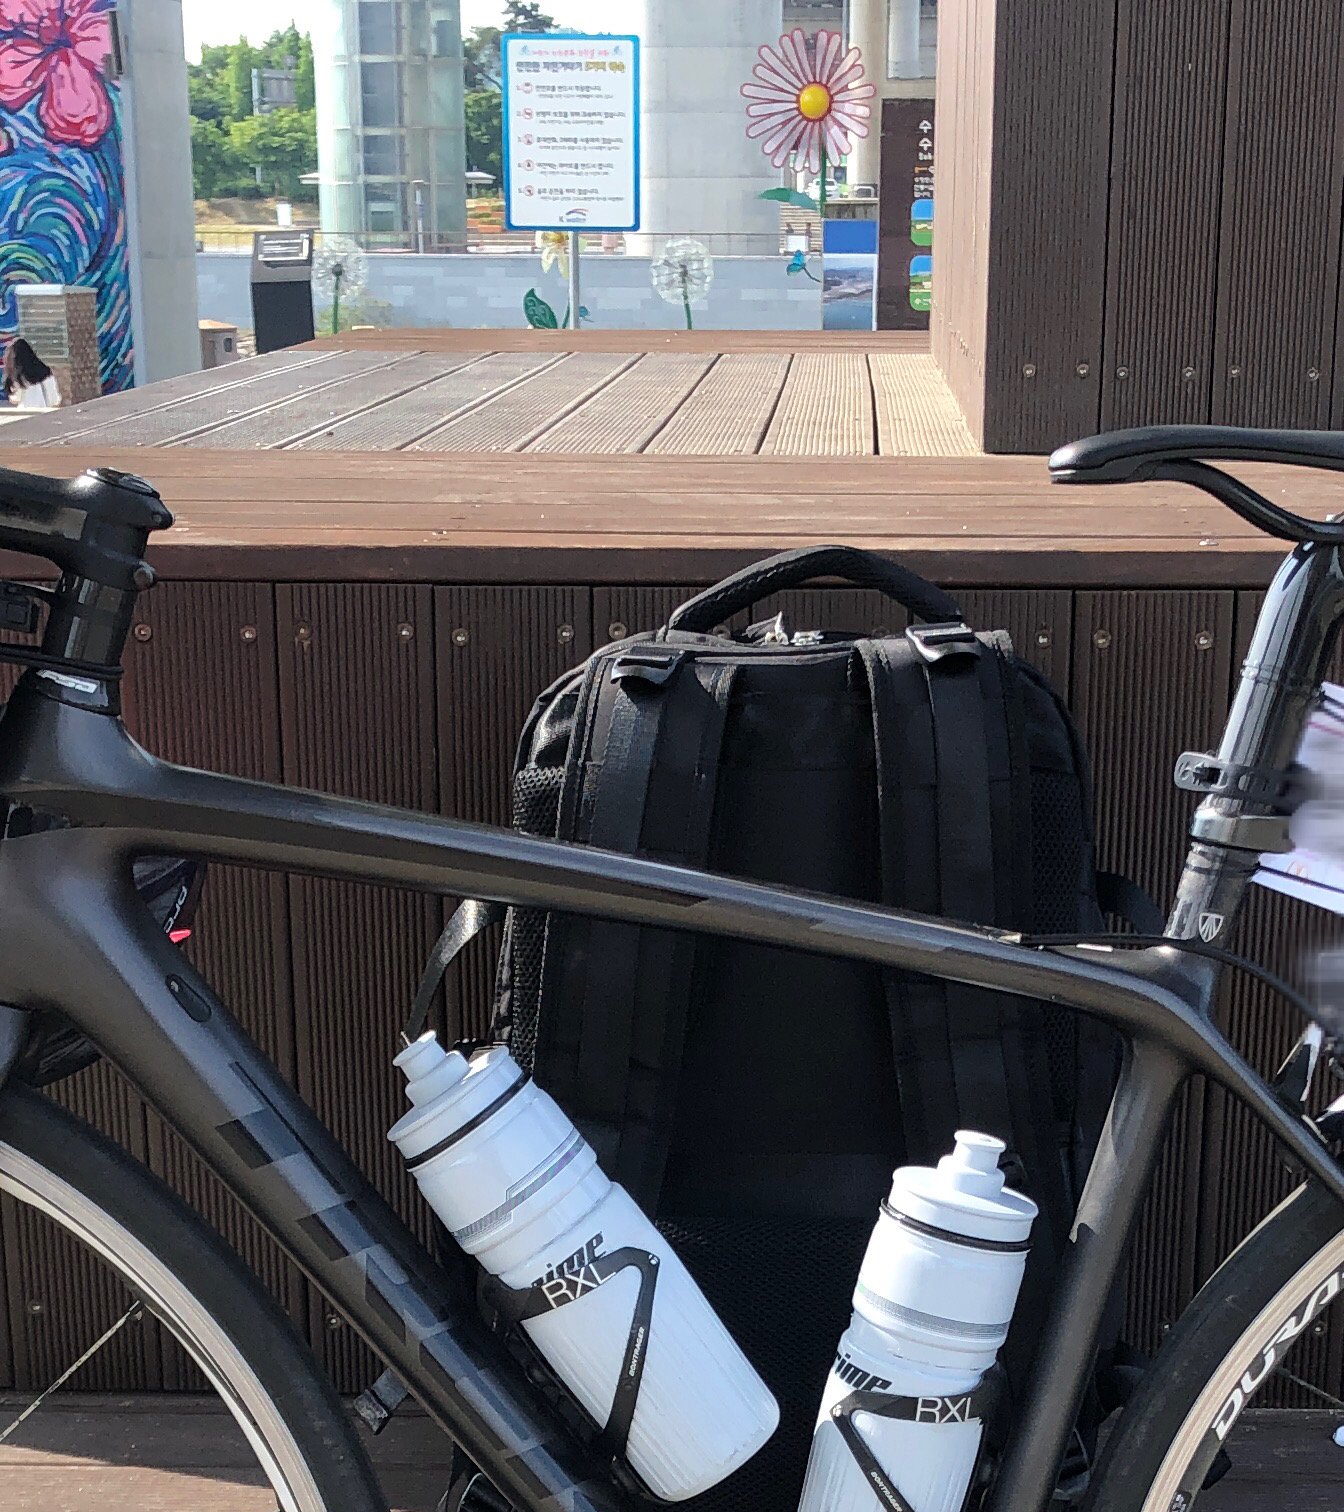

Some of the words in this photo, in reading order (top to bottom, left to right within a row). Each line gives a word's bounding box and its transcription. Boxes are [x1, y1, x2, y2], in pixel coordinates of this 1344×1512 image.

[541, 1263, 617, 1309] RXL
[628, 1326, 646, 1377] BONTRAGER
[915, 1396, 982, 1425] RXL
[870, 1470, 903, 1512] BONTRAGER
